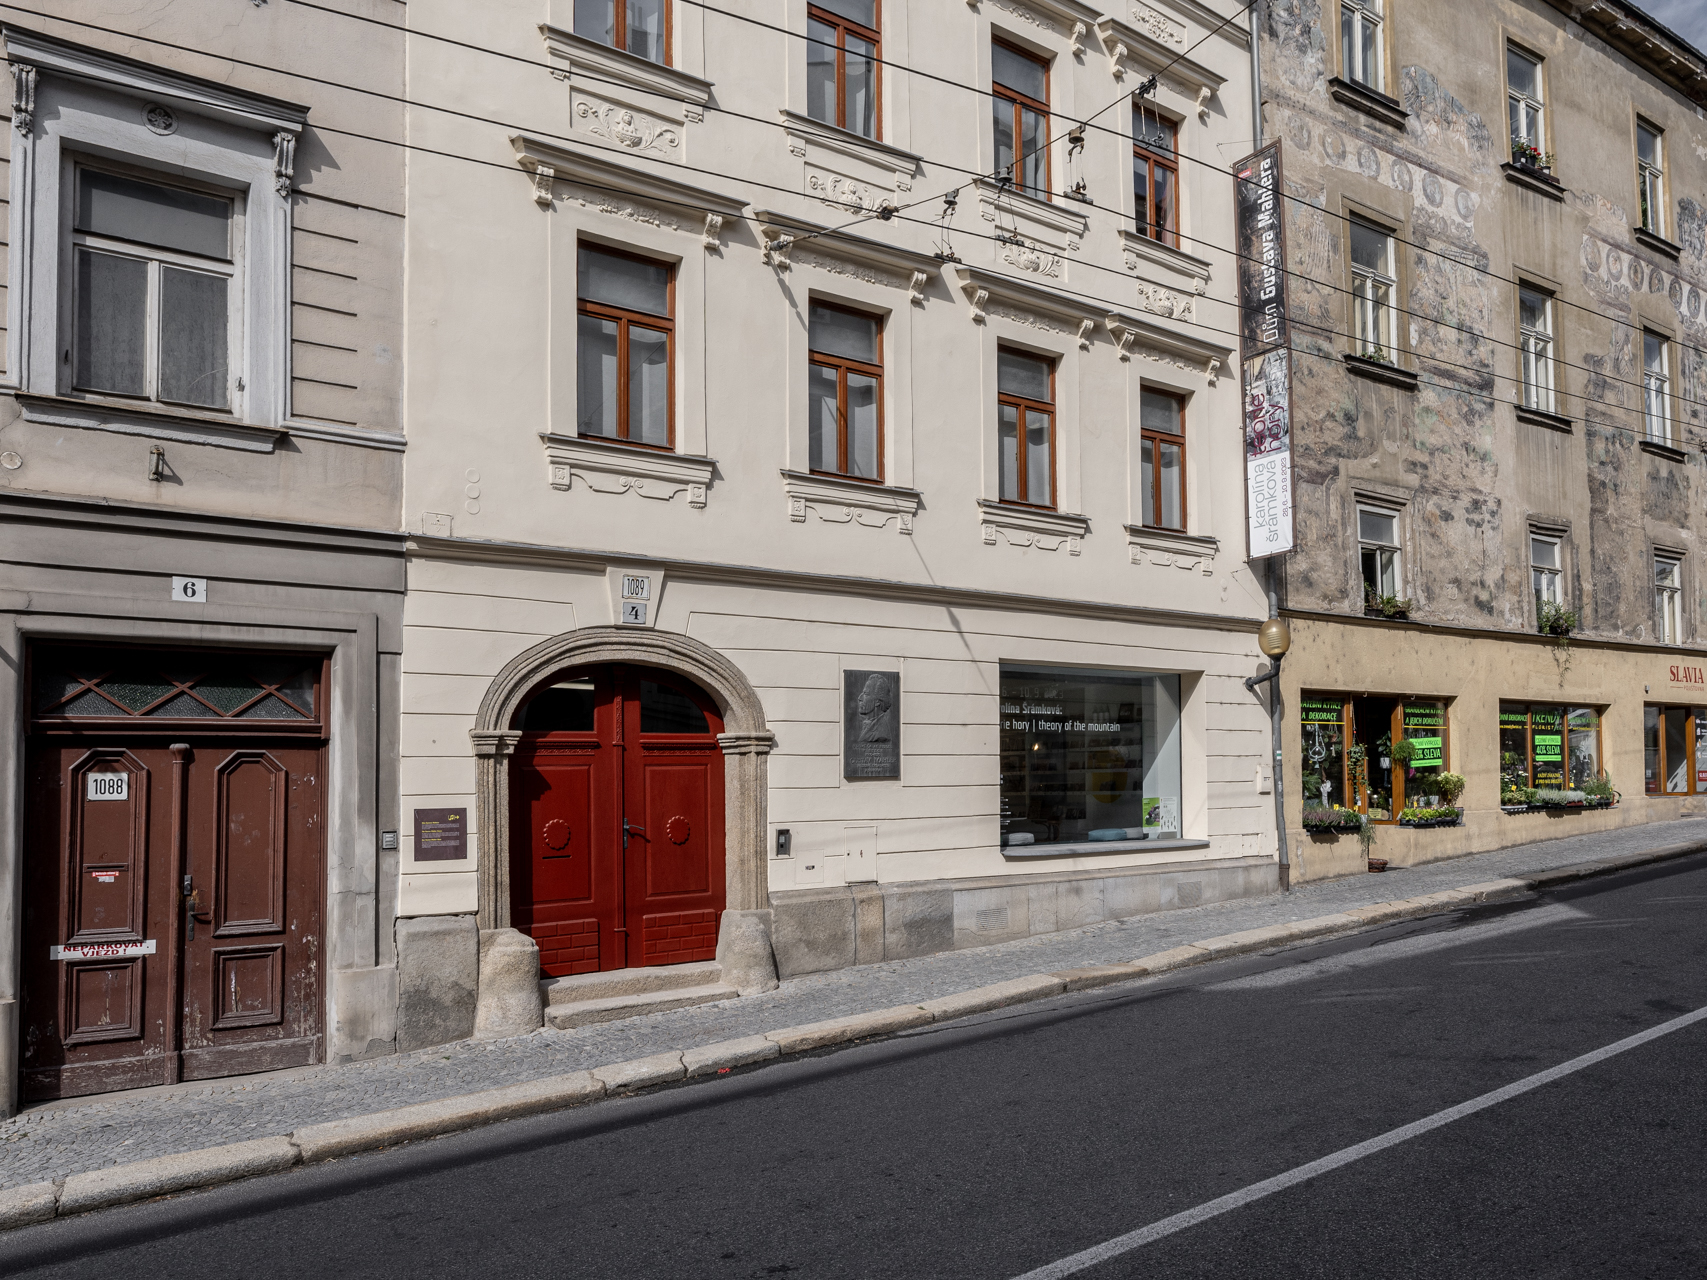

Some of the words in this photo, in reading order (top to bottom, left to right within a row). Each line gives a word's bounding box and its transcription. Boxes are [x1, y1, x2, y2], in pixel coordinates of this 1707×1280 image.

[1257, 158, 1273, 229] Mahlera
[1260, 230, 1276, 300] Gustava
[1262, 303, 1279, 343] Dům
[1250, 393, 1267, 457] teorie
[1266, 404, 1285, 453] hory
[1252, 463, 1266, 529] karolína
[1265, 460, 1279, 543] šrámková
[182, 581, 197, 598] 6
[627, 578, 645, 596] 1089
[629, 606, 640, 620] 4
[1669, 665, 1704, 684] SLAVIA
[1000, 702, 1020, 714] olína
[1022, 701, 1063, 715] Šrámková:
[1308, 711, 1338, 721] DEKORACE
[1012, 719, 1030, 732] hory
[1038, 720, 1062, 733] theory
[1064, 720, 1072, 731] of
[1073, 721, 1085, 731] the
[1087, 722, 1120, 732] mountain
[1424, 748, 1441, 759] SLEVA
[1546, 745, 1561, 755] SLEVA
[93, 778, 123, 795] 1088
[63, 941, 144, 953] NEPARKOVAT
[82, 949, 119, 957] VJEZD
